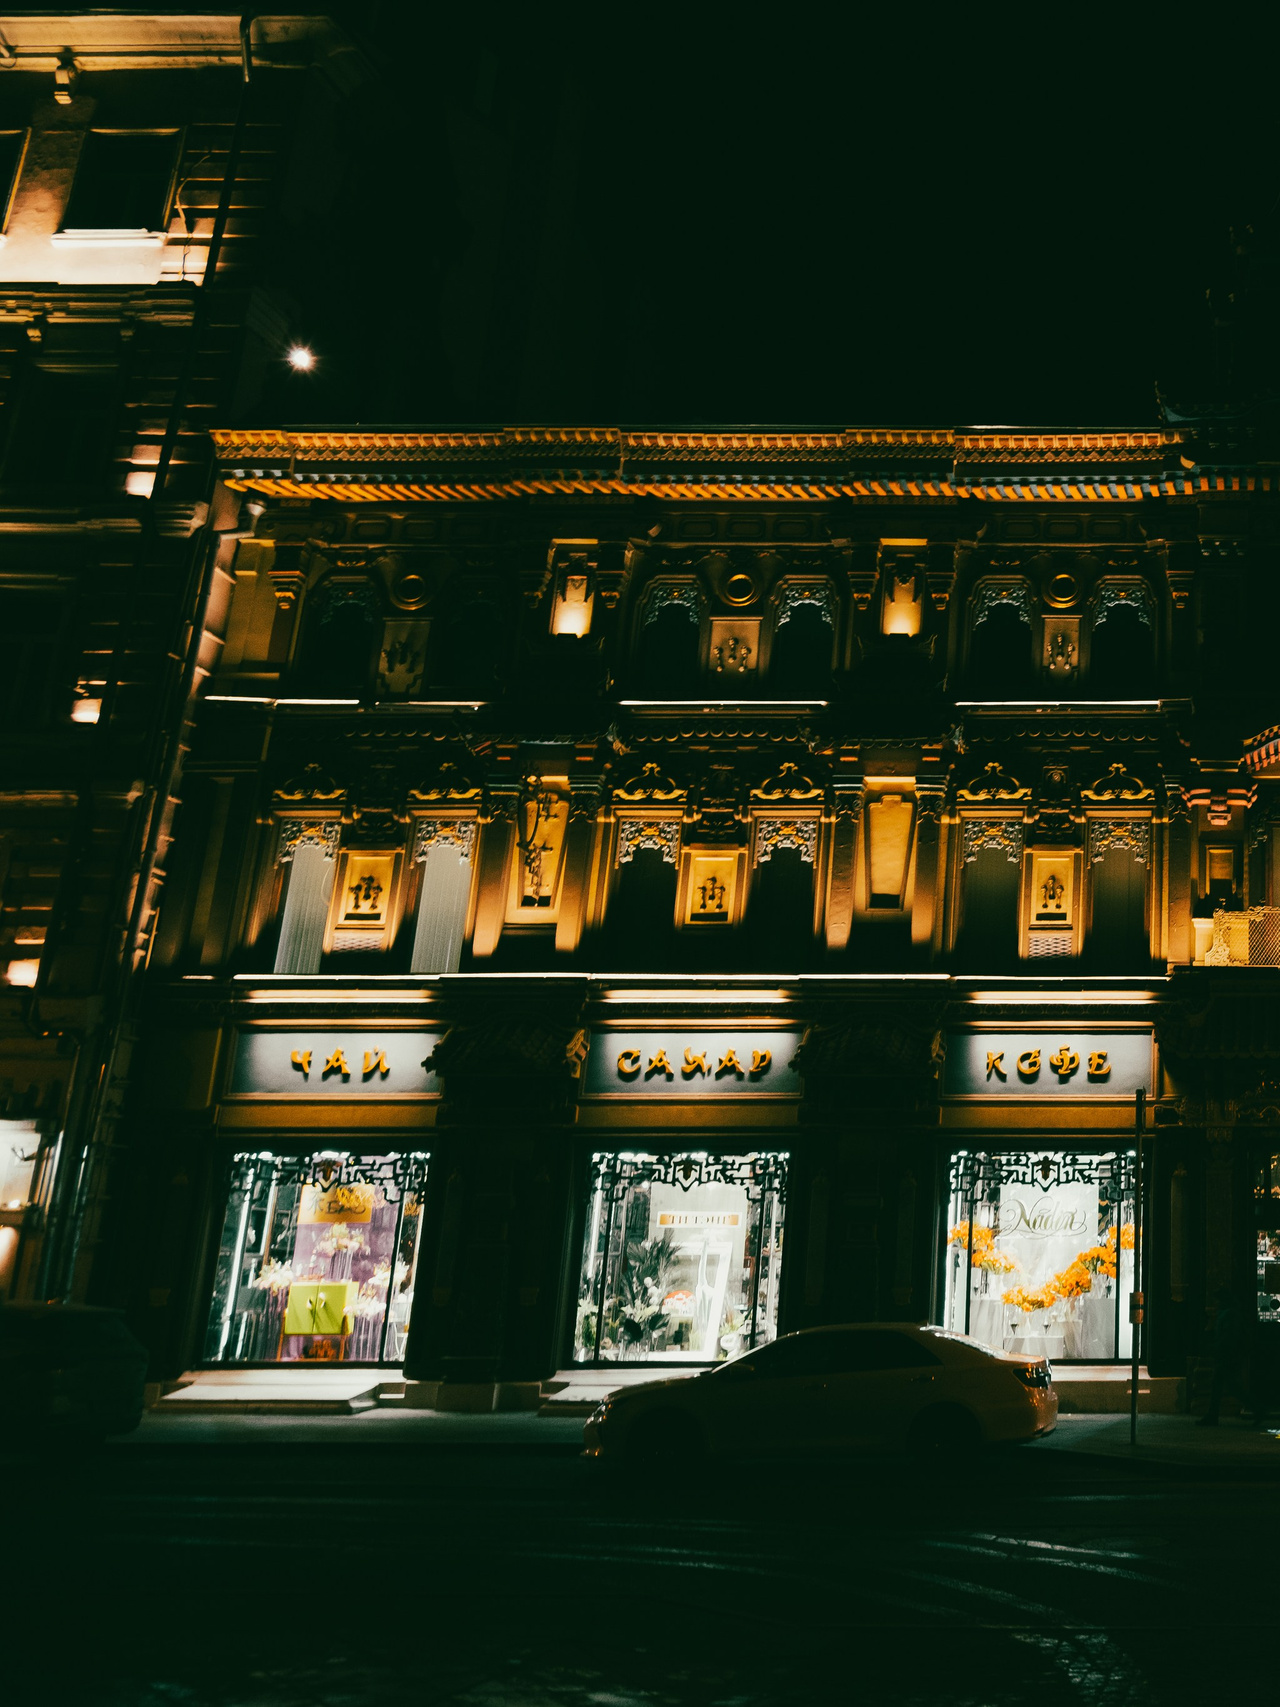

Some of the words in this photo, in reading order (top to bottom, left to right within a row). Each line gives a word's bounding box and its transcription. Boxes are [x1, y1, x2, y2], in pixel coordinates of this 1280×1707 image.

[290, 1046, 390, 1075] ЧАЙ
[616, 1047, 773, 1075] САХАР
[986, 1044, 1112, 1076] КОФЕ
